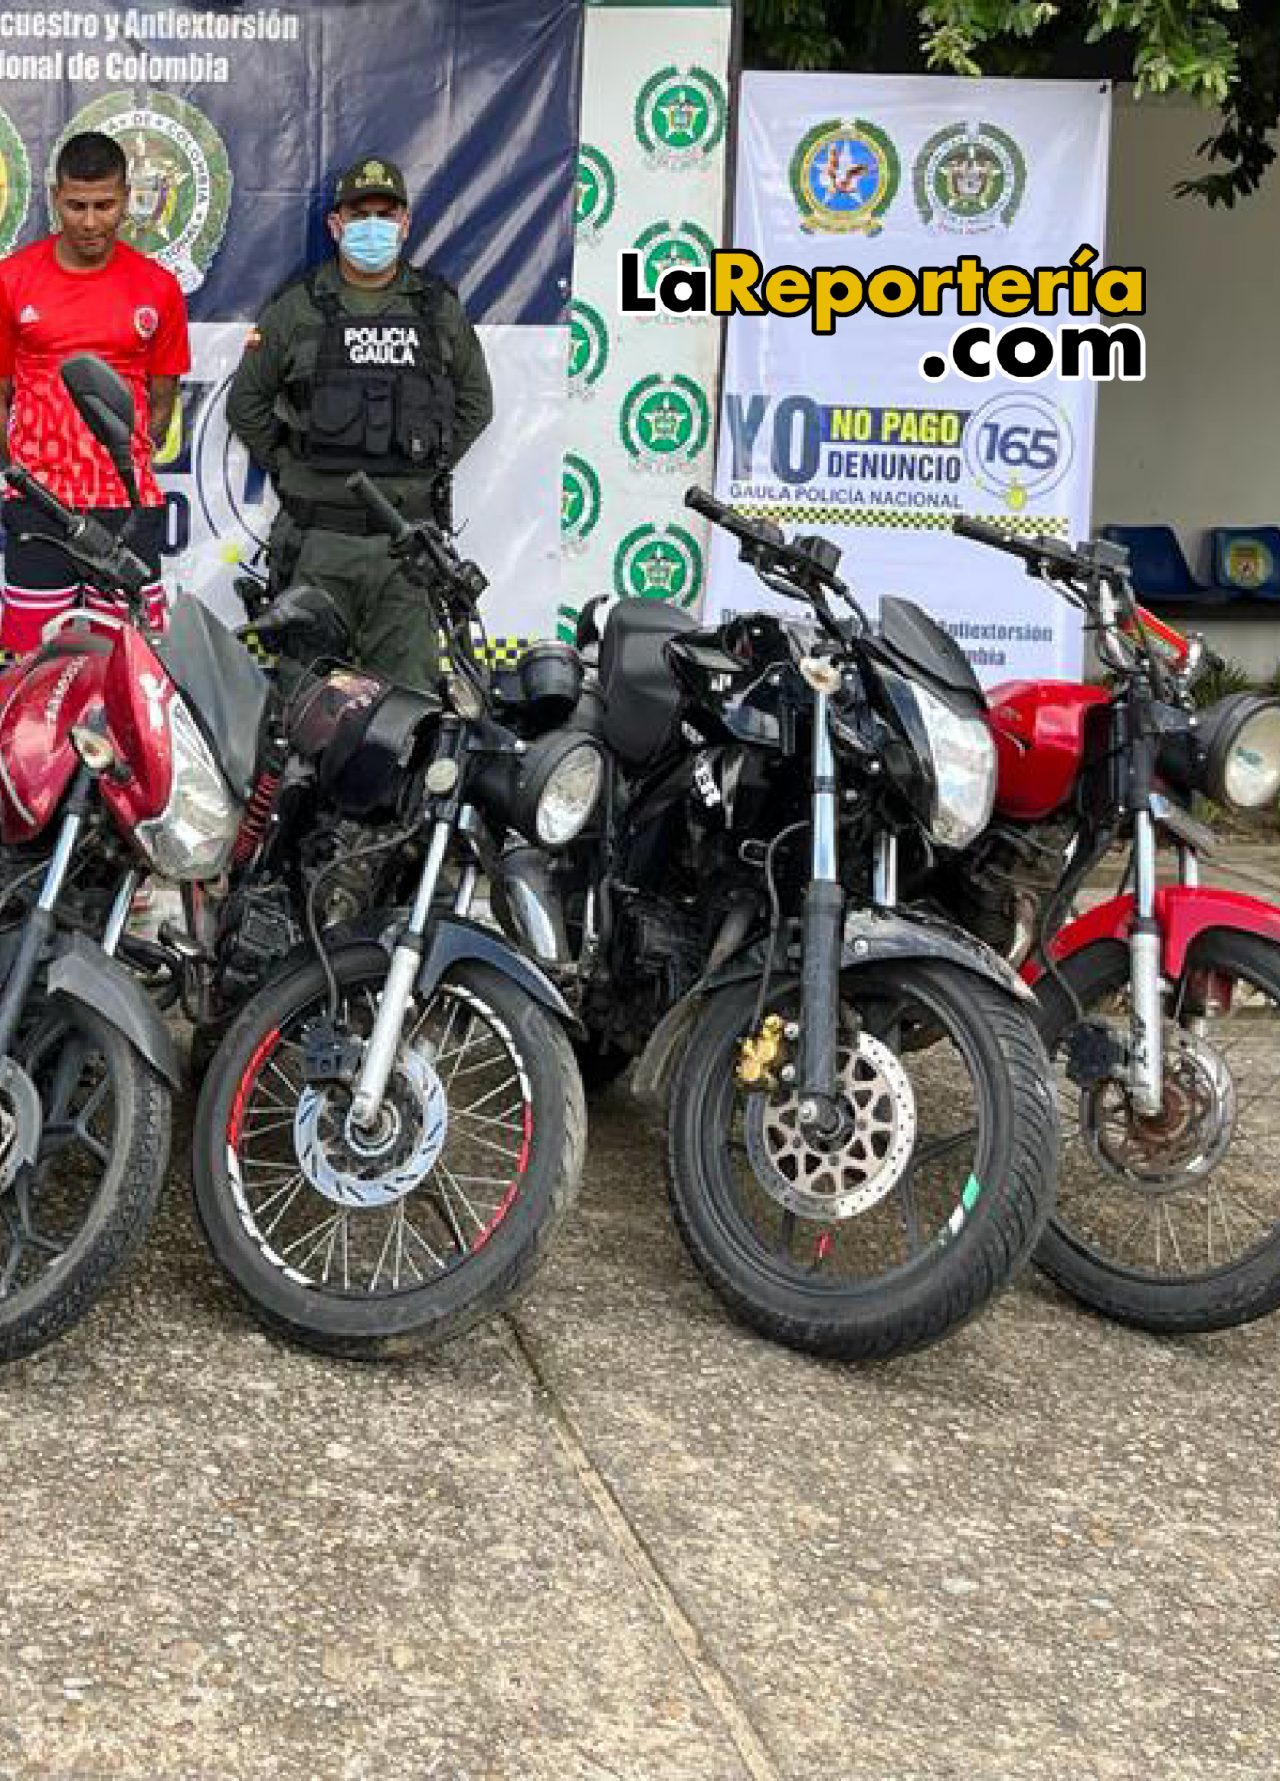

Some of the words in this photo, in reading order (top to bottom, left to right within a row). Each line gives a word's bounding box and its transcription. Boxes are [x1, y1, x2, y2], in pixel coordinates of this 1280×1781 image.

[102, 15, 118, 43] y
[124, 10, 299, 41] Antiextorsión
[68, 52, 99, 82] de
[105, 53, 229, 83] Colombia
[344, 327, 420, 348] POLICIA
[349, 344, 415, 367] GAULA
[724, 394, 821, 485] YO
[829, 409, 871, 442] NO
[881, 410, 960, 446] PAGO
[980, 422, 1060, 470] 165
[827, 450, 962, 484] DENUNCIO
[730, 485, 791, 501] GAULA
[869, 490, 963, 509] NACIONAL
